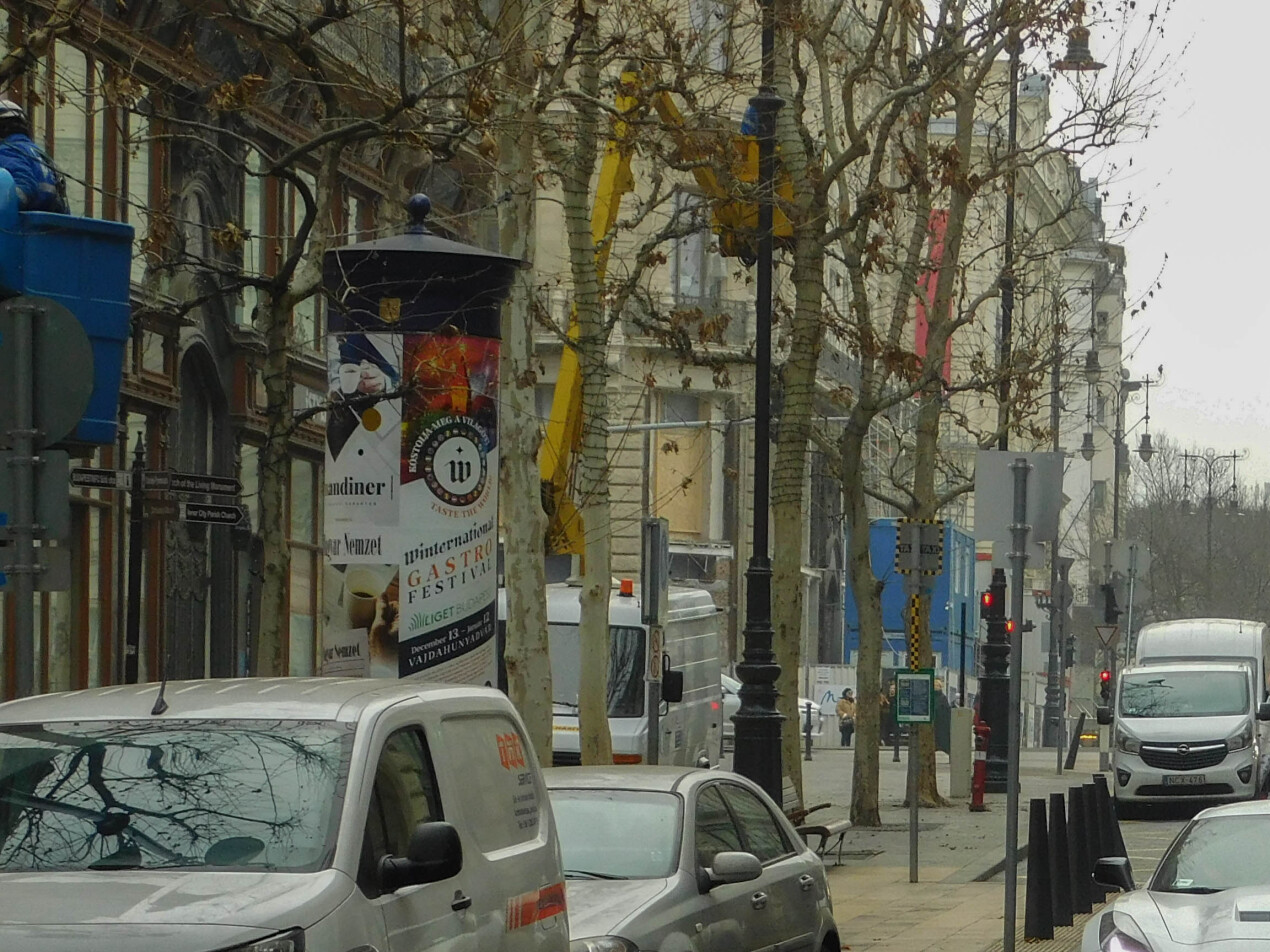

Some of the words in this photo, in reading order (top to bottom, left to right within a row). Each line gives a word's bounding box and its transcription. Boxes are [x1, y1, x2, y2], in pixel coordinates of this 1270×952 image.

[431, 415, 453, 430] MEG
[454, 415, 461, 423] A
[328, 476, 386, 495] andiner
[431, 501, 459, 518] TASTE
[462, 506, 478, 518] THE
[344, 533, 382, 556] Nemzet
[408, 538, 492, 588] GASTRO
[408, 558, 491, 604] FESTIVAL
[425, 606, 455, 626] LIGET
[411, 636, 447, 655] December
